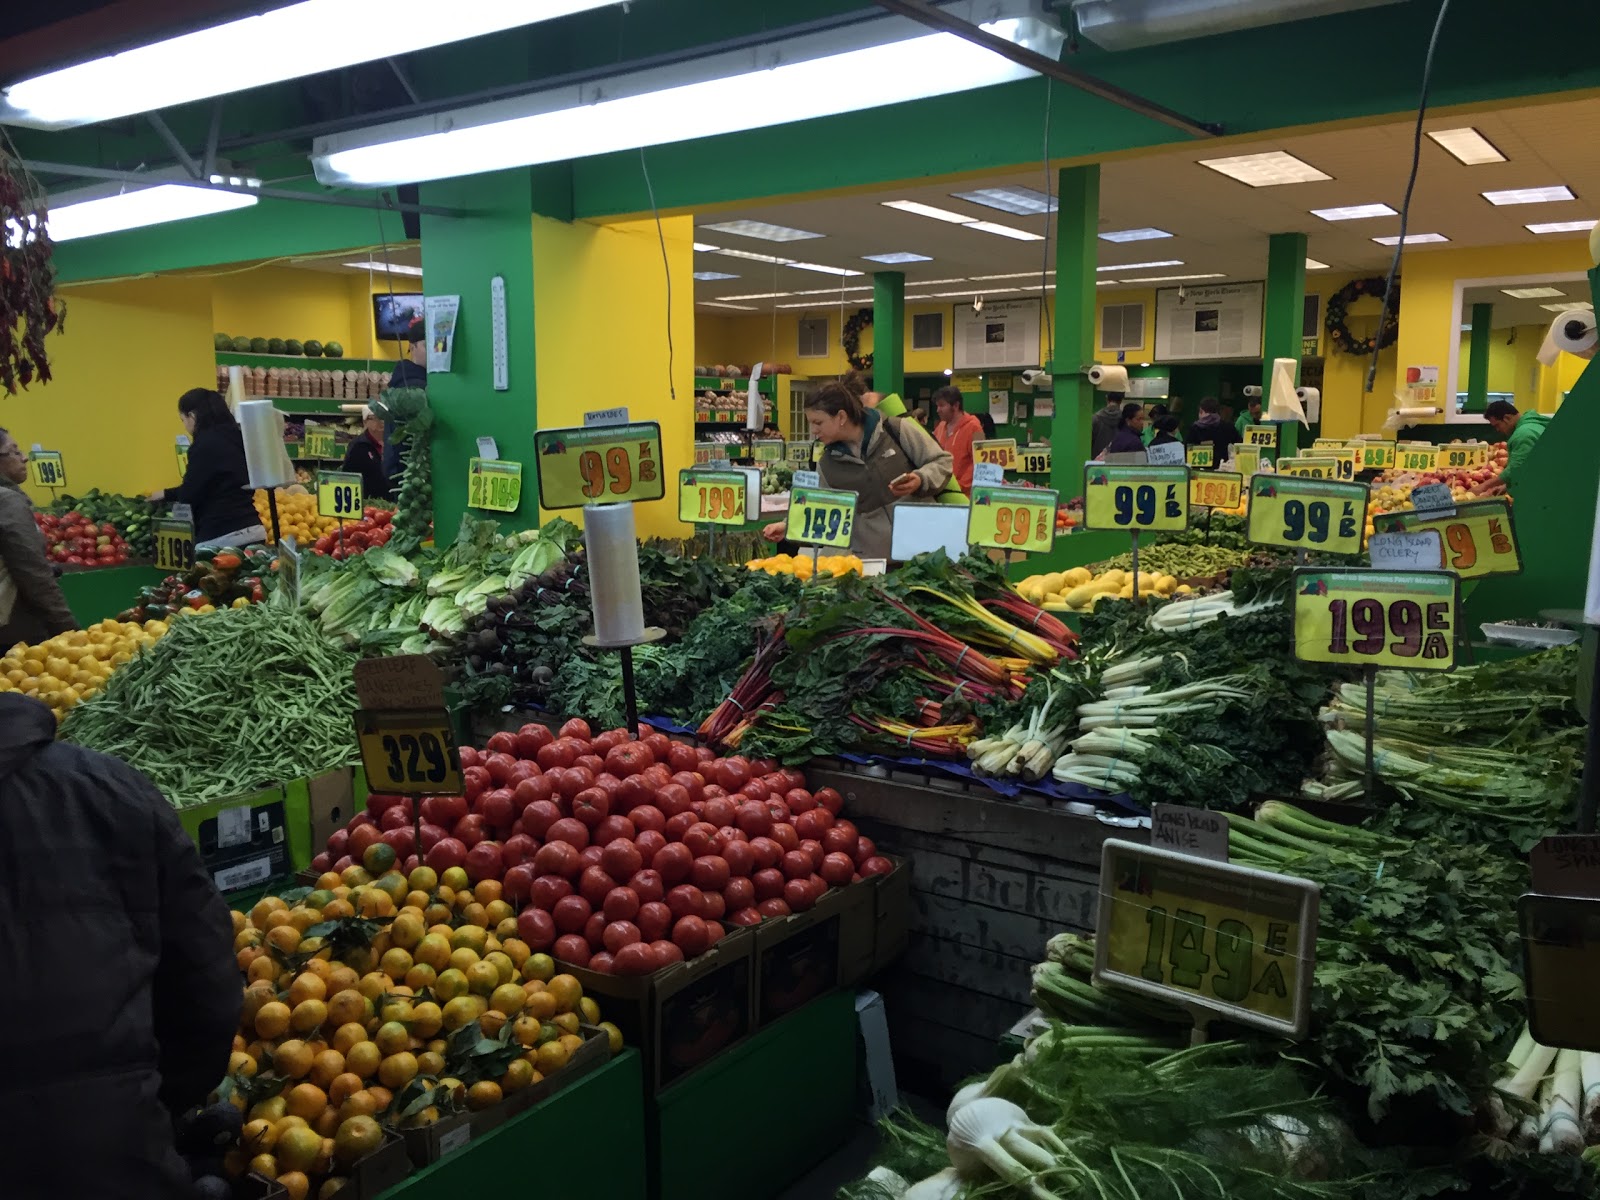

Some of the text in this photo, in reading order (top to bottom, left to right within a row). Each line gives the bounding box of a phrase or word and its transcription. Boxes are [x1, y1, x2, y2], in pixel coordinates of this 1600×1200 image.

[38, 461, 57, 484] 199
[579, 447, 632, 499] 99
[1024, 456, 1046, 472] 199
[1404, 453, 1428, 470] 149
[1449, 451, 1467, 467] 99
[335, 486, 352, 514] 99
[471, 476, 483, 506] 2
[491, 478, 521, 509] 149
[698, 487, 735, 520] 199
[1114, 484, 1182, 525] 99 LB
[1195, 482, 1229, 506] 199
[802, 507, 842, 541] 149
[994, 507, 1031, 546] 99
[1283, 499, 1357, 543] 99 LB
[168, 537, 193, 571] 199
[1373, 536, 1402, 547] LONG
[1379, 547, 1420, 564] CELERY
[1328, 598, 1449, 659] 199 EA
[383, 732, 446, 783] 329
[1154, 809, 1186, 827] LONG
[1155, 826, 1200, 849] ANISE
[1141, 906, 1290, 1002] 149 EA
